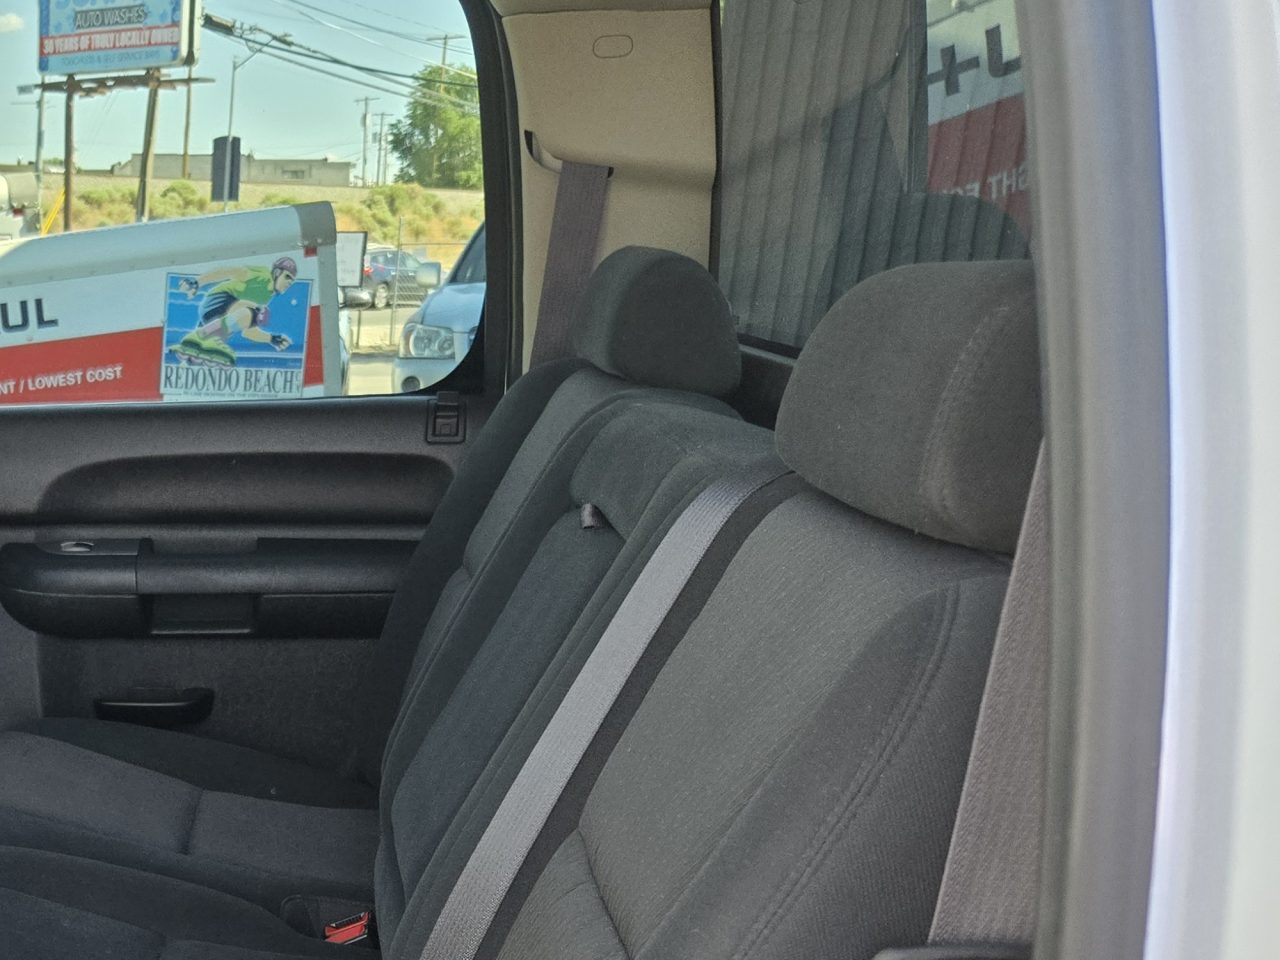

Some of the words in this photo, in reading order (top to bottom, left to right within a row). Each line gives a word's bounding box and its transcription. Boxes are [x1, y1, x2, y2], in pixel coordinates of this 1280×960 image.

[75, 11, 101, 28] AUTO
[103, 7, 145, 25] WASHES
[28, 370, 83, 391] LOWEST
[86, 365, 123, 383] COST
[164, 366, 239, 392] REDONDO
[244, 370, 295, 393] BEACH
